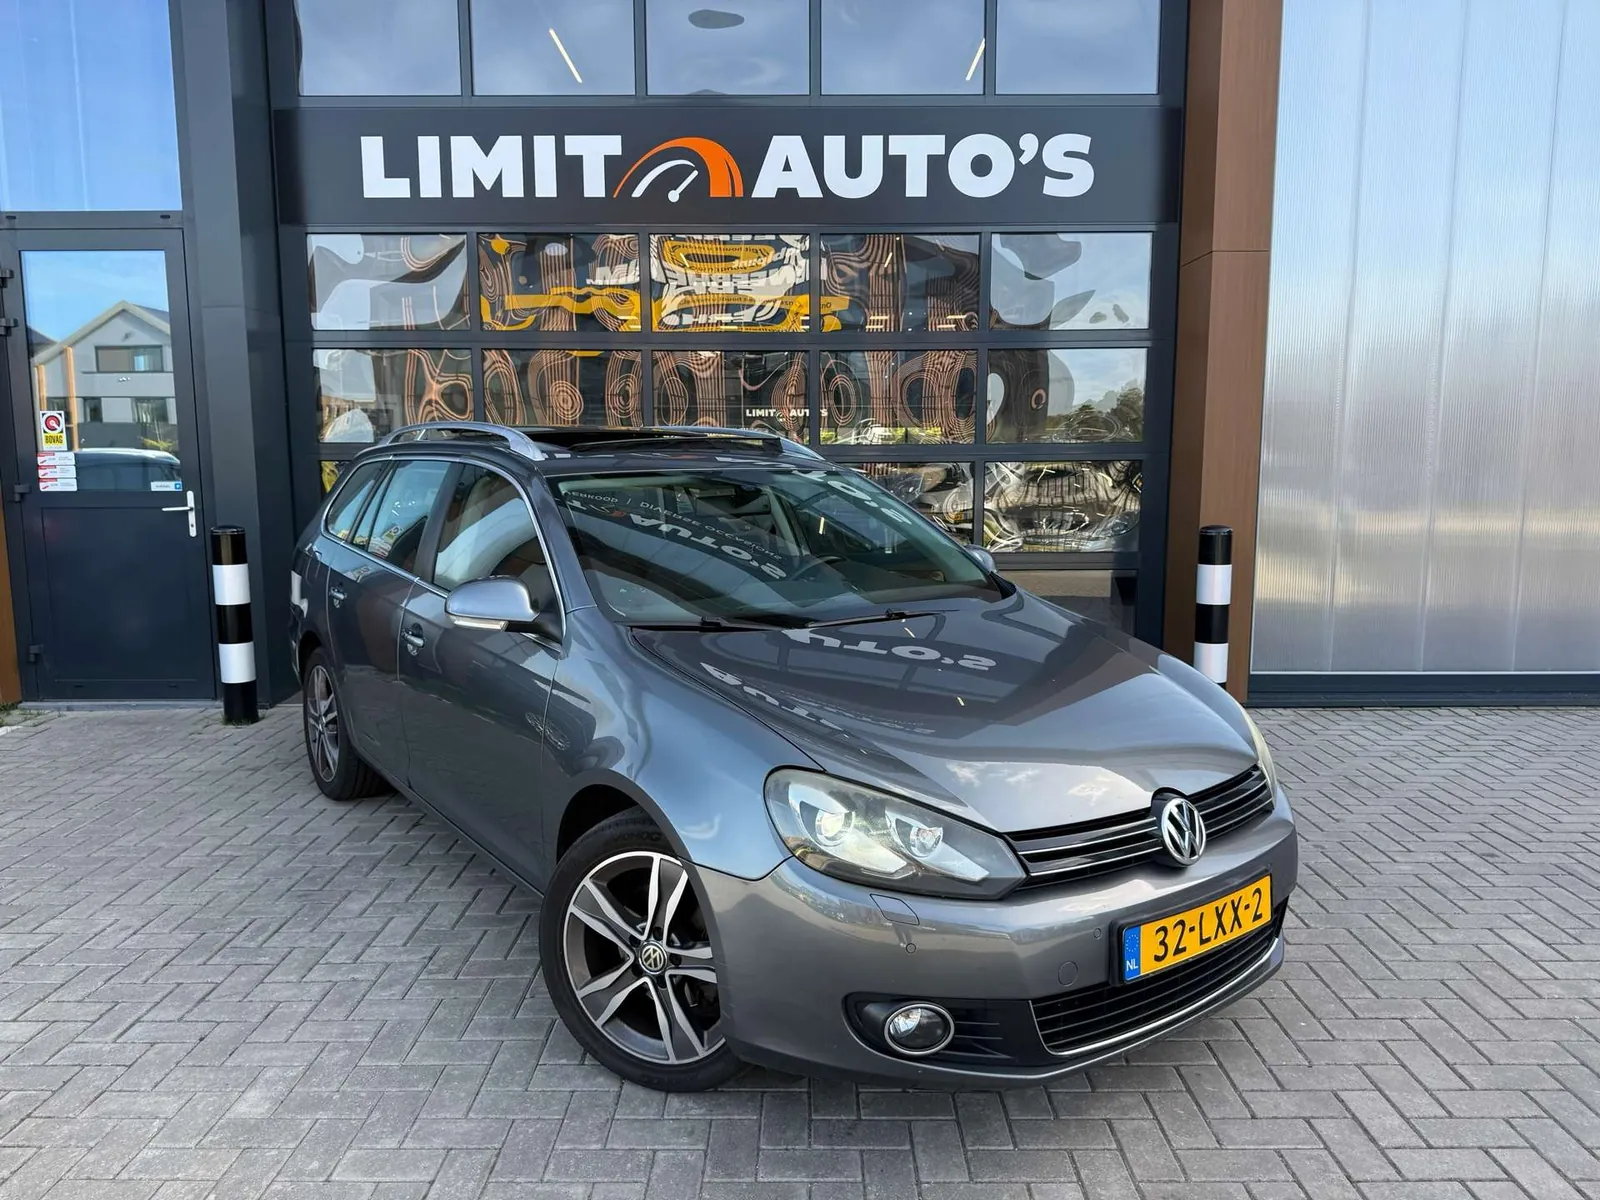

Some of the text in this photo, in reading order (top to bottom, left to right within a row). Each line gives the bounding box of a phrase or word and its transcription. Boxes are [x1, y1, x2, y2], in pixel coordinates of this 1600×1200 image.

[360, 132, 1095, 199] LIMIT AUTO'S
[745, 408, 777, 418] LIMIT
[44, 434, 64, 445] BOVAG
[1153, 887, 1263, 963] 32-LXX-2
[1126, 958, 1139, 972] NL
